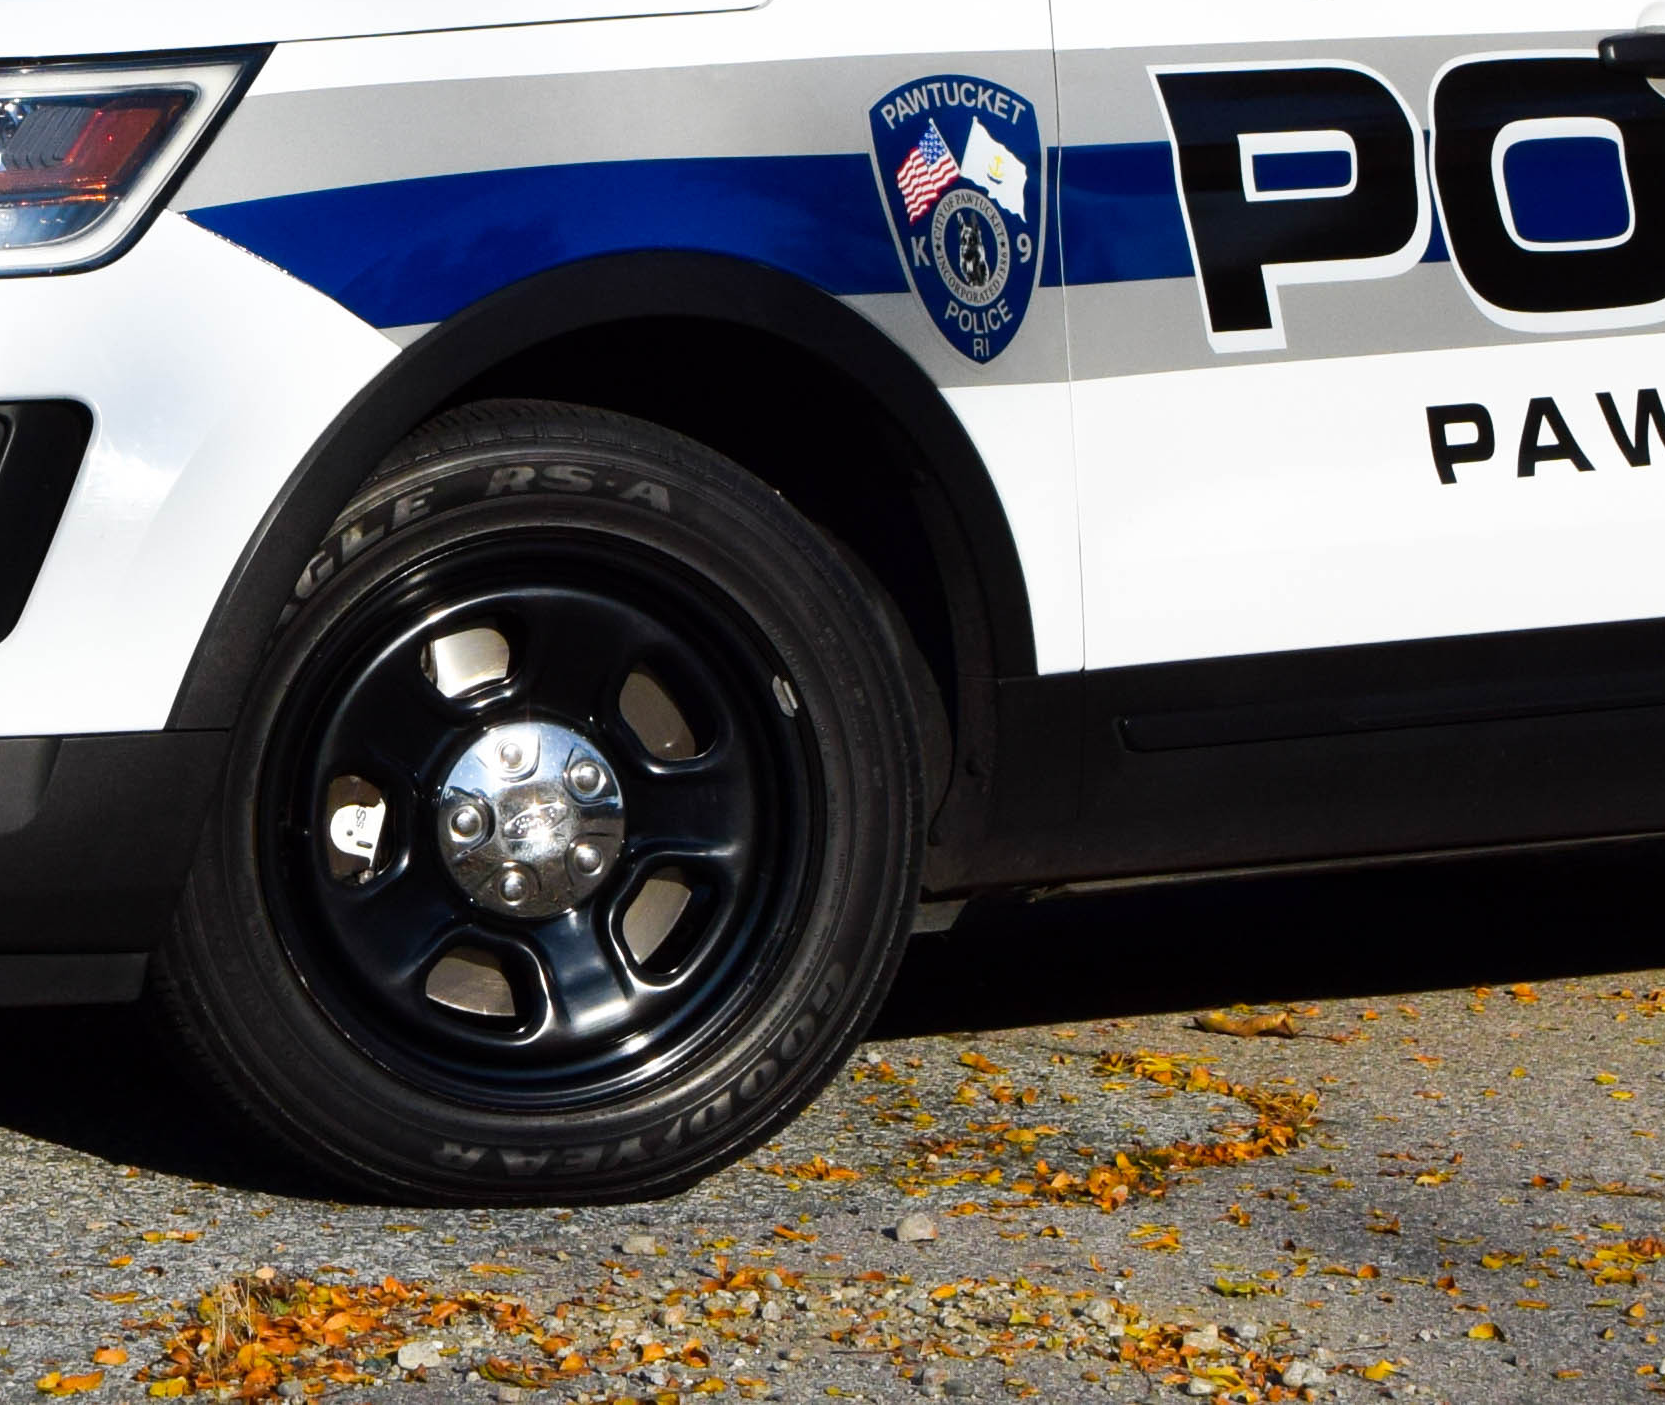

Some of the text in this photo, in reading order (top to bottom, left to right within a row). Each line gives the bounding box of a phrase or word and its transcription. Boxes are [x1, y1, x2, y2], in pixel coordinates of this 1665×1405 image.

[881, 82, 1026, 131] PAWTUCKET
[934, 192, 1005, 241] CITY OF PAWTUCKET
[910, 233, 1032, 267] K 9
[937, 255, 1000, 303] INCORPORATED
[944, 299, 1013, 335] POLICE
[973, 337, 990, 357] RI
[284, 487, 436, 609] GLE
